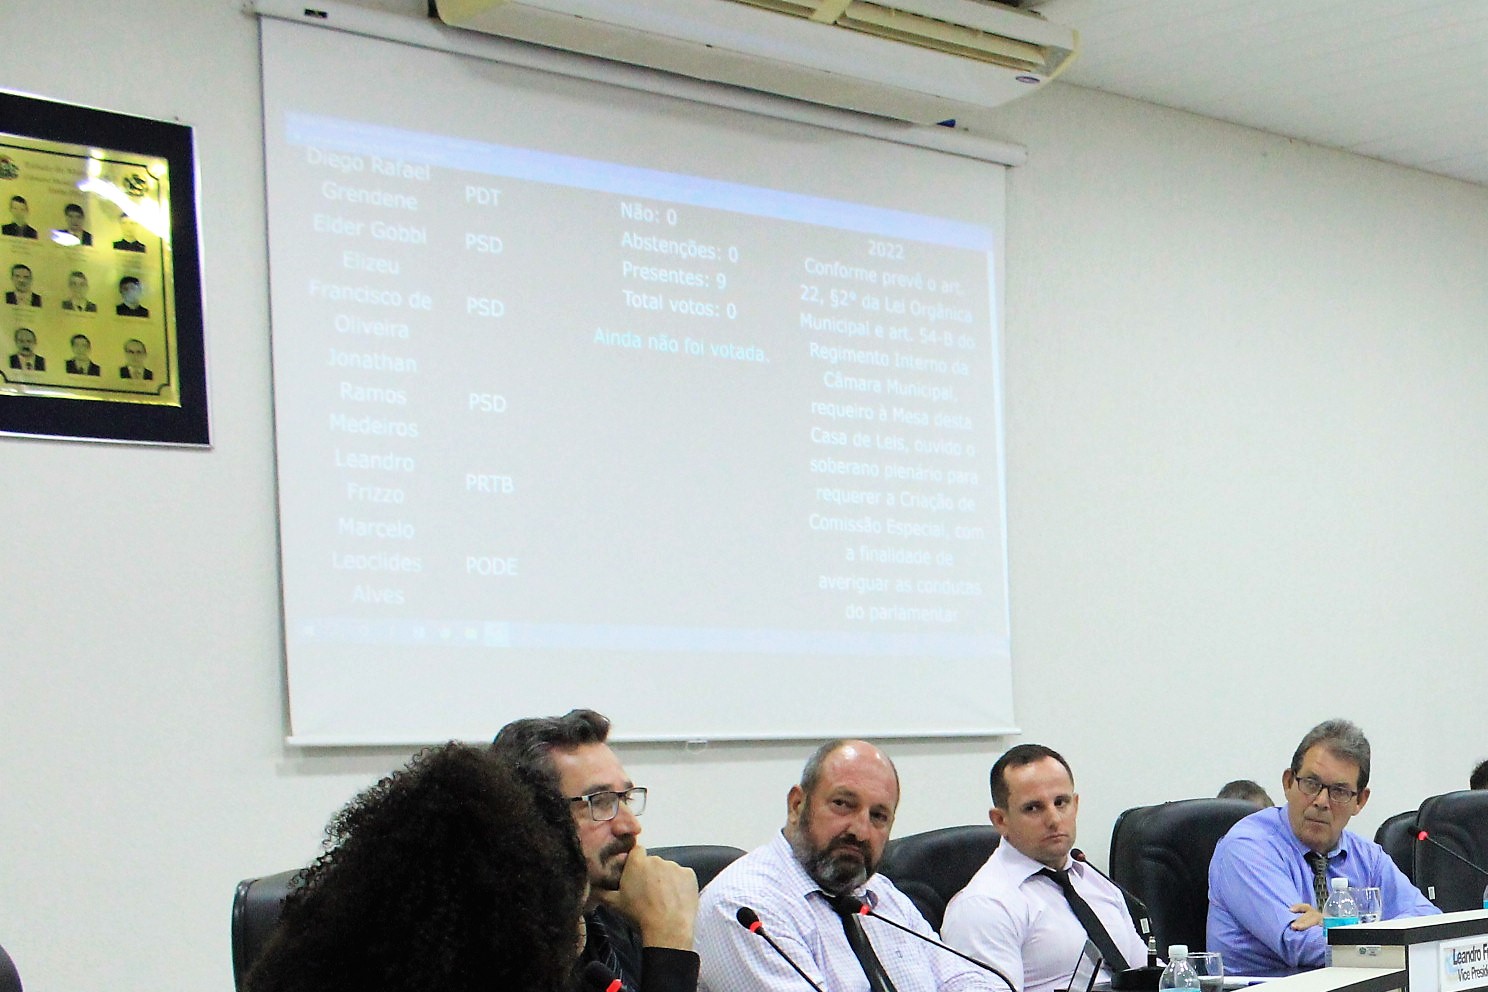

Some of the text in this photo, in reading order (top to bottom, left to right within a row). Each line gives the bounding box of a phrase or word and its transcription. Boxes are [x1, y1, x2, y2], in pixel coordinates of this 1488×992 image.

[306, 146, 431, 181] Diego Rafael
[321, 180, 418, 210] Grendene
[465, 185, 502, 206] PDT
[620, 201, 678, 227] Não: 0
[370, 220, 427, 244] Gobbi
[465, 232, 503, 254] PSD
[620, 231, 738, 263] Abstenções: 0
[868, 239, 905, 260] 2022
[343, 251, 400, 275] Elizeu
[621, 260, 727, 290] Presentes: 9
[804, 257, 877, 283] Conforme
[927, 279, 936, 291] o
[308, 278, 433, 310] Francisco de
[622, 289, 737, 320] Total votos: 0
[861, 295, 879, 310] da
[884, 296, 905, 314] Lei
[466, 296, 505, 317] PSD
[334, 314, 410, 339] Oliveira
[800, 312, 870, 337] Municipal
[875, 325, 884, 338] e
[957, 333, 976, 349] do
[593, 327, 770, 363] Ainda não foi votada.
[328, 348, 417, 373] Jonathan
[809, 342, 969, 376] Regimento Interno da
[340, 381, 407, 406] Ramos
[823, 371, 882, 393] Câmara
[468, 393, 507, 413] PSD
[811, 400, 874, 421] requeiro
[893, 406, 929, 425] Mesa
[934, 412, 973, 430] desta
[329, 413, 419, 438] Medeiros
[810, 426, 847, 446] Casa
[852, 433, 871, 447] de
[914, 439, 961, 457] ouvido
[966, 444, 975, 457] o
[334, 449, 415, 472] Leandro
[810, 457, 879, 477] soberano
[947, 470, 979, 485] para
[347, 482, 404, 504] Frizzo
[465, 473, 514, 494] PRTB
[816, 487, 881, 506] requerer
[886, 493, 895, 506] a
[958, 497, 975, 512] de
[338, 517, 415, 539] Marcelo
[808, 513, 882, 534] Comissão
[954, 525, 984, 540] com
[465, 556, 518, 576] PODE
[845, 544, 954, 567] a finalidade de
[352, 584, 405, 605] Alves
[818, 574, 889, 596] averiguar
[895, 578, 911, 593] as
[845, 604, 864, 620] do
[1453, 946, 1482, 966] Leandro
[1458, 967, 1470, 982] Vice
